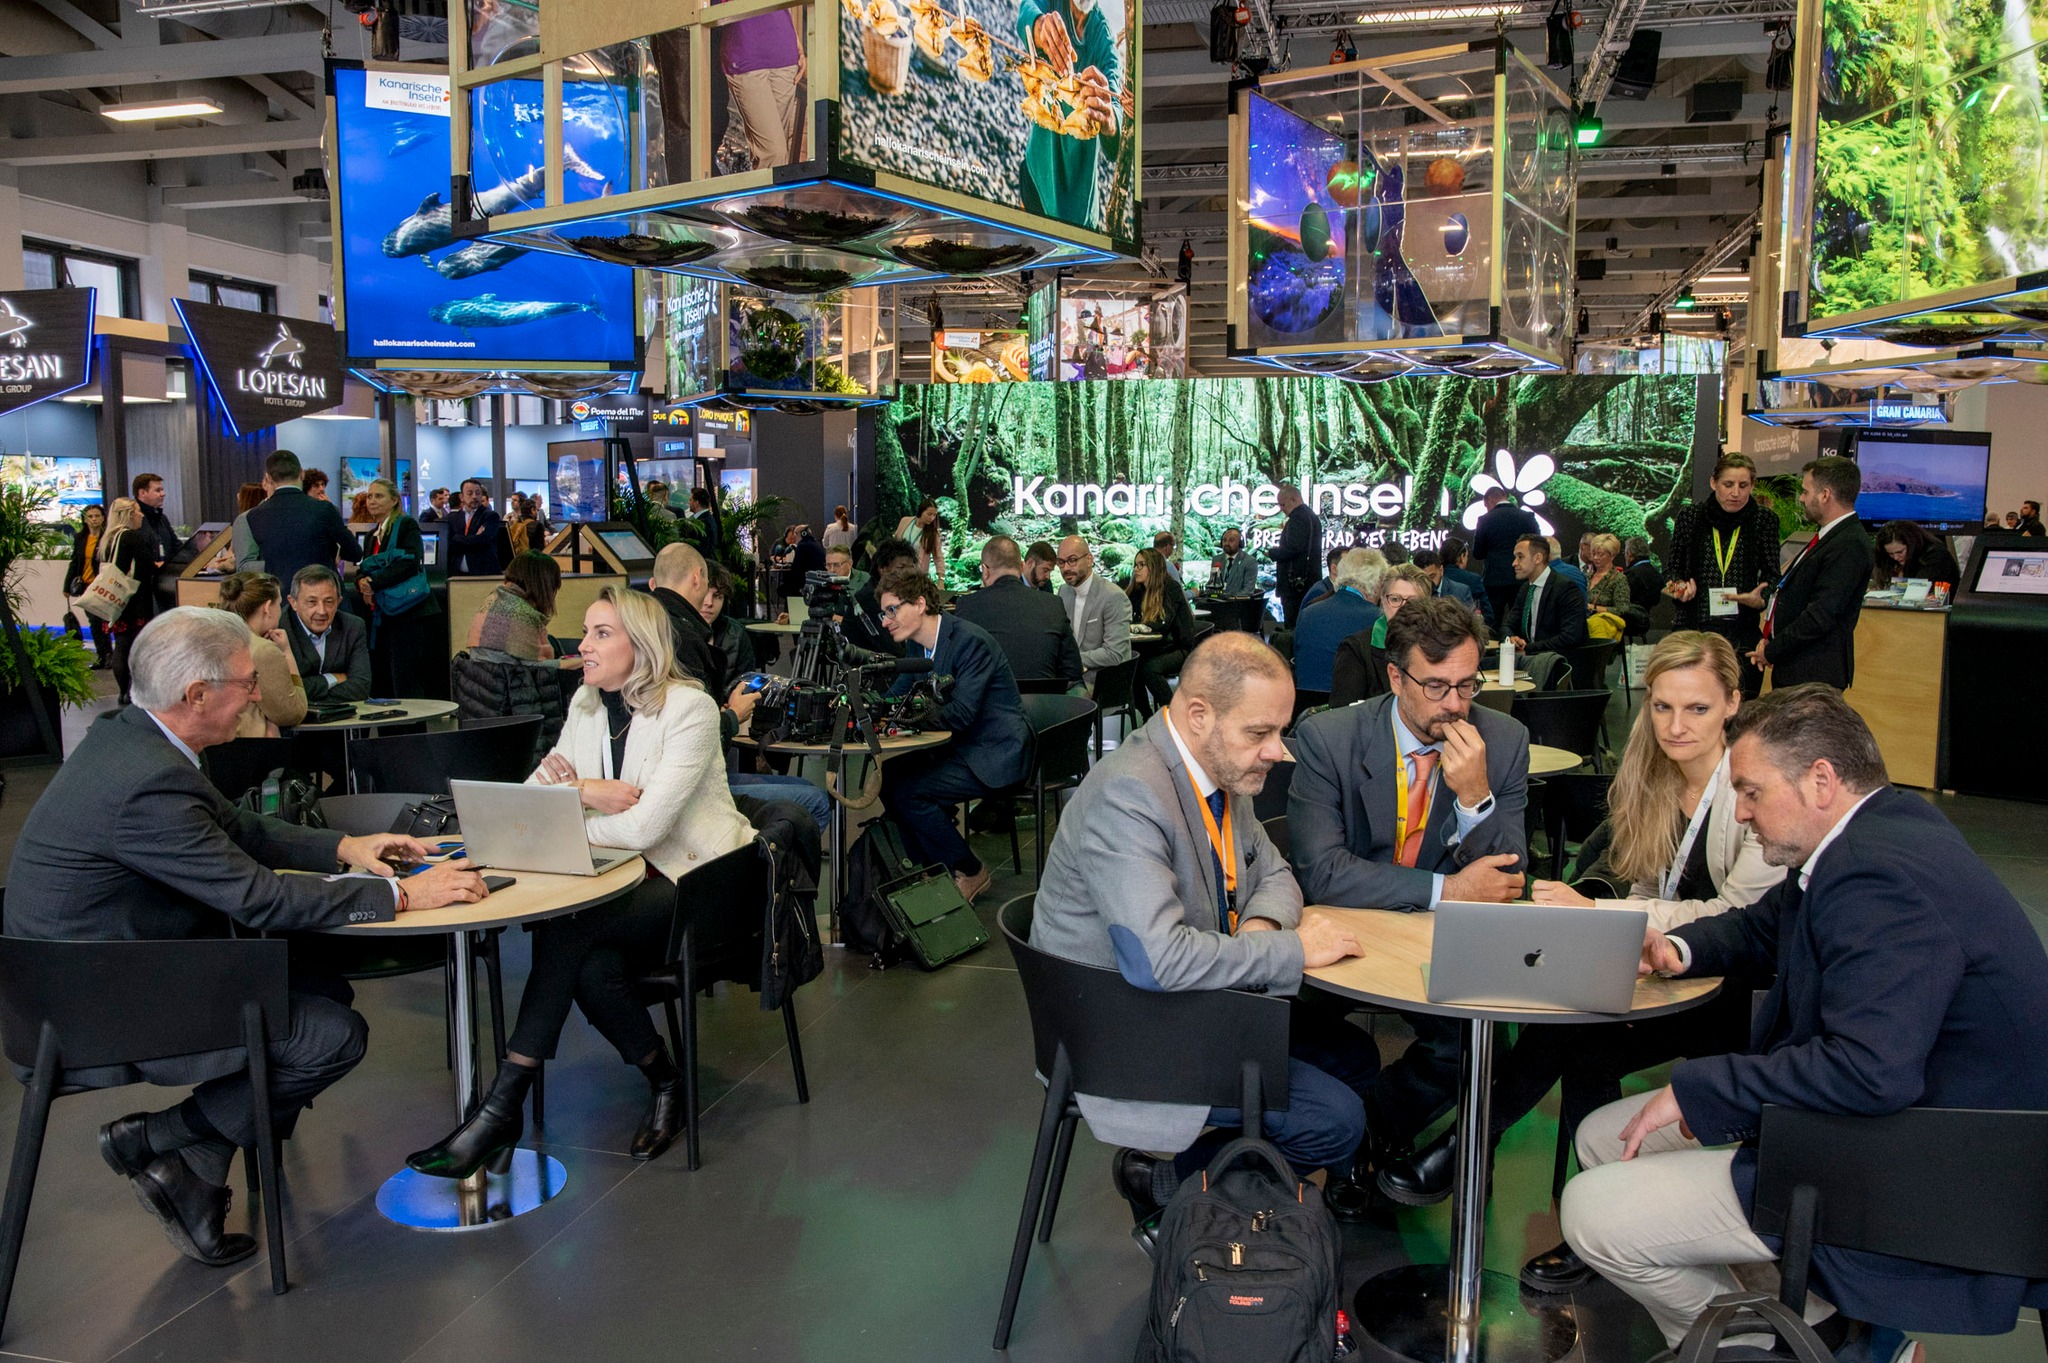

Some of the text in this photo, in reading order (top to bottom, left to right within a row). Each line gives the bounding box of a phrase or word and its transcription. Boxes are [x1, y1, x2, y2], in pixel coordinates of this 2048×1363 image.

[379, 78, 442, 94] Kanarische
[409, 91, 442, 103] Inseln
[874, 133, 988, 177] hallokanarischeinseln.com
[373, 339, 476, 348] hallokanarischeinseln.com
[6, 384, 33, 394] GROUP
[238, 368, 327, 400] LOPESAN
[264, 397, 307, 408] HOTEL GROUP
[590, 407, 616, 416] Poema
[617, 407, 629, 416] del
[629, 407, 645, 416] Mar
[1876, 405, 1941, 419] GRAN CANARIA
